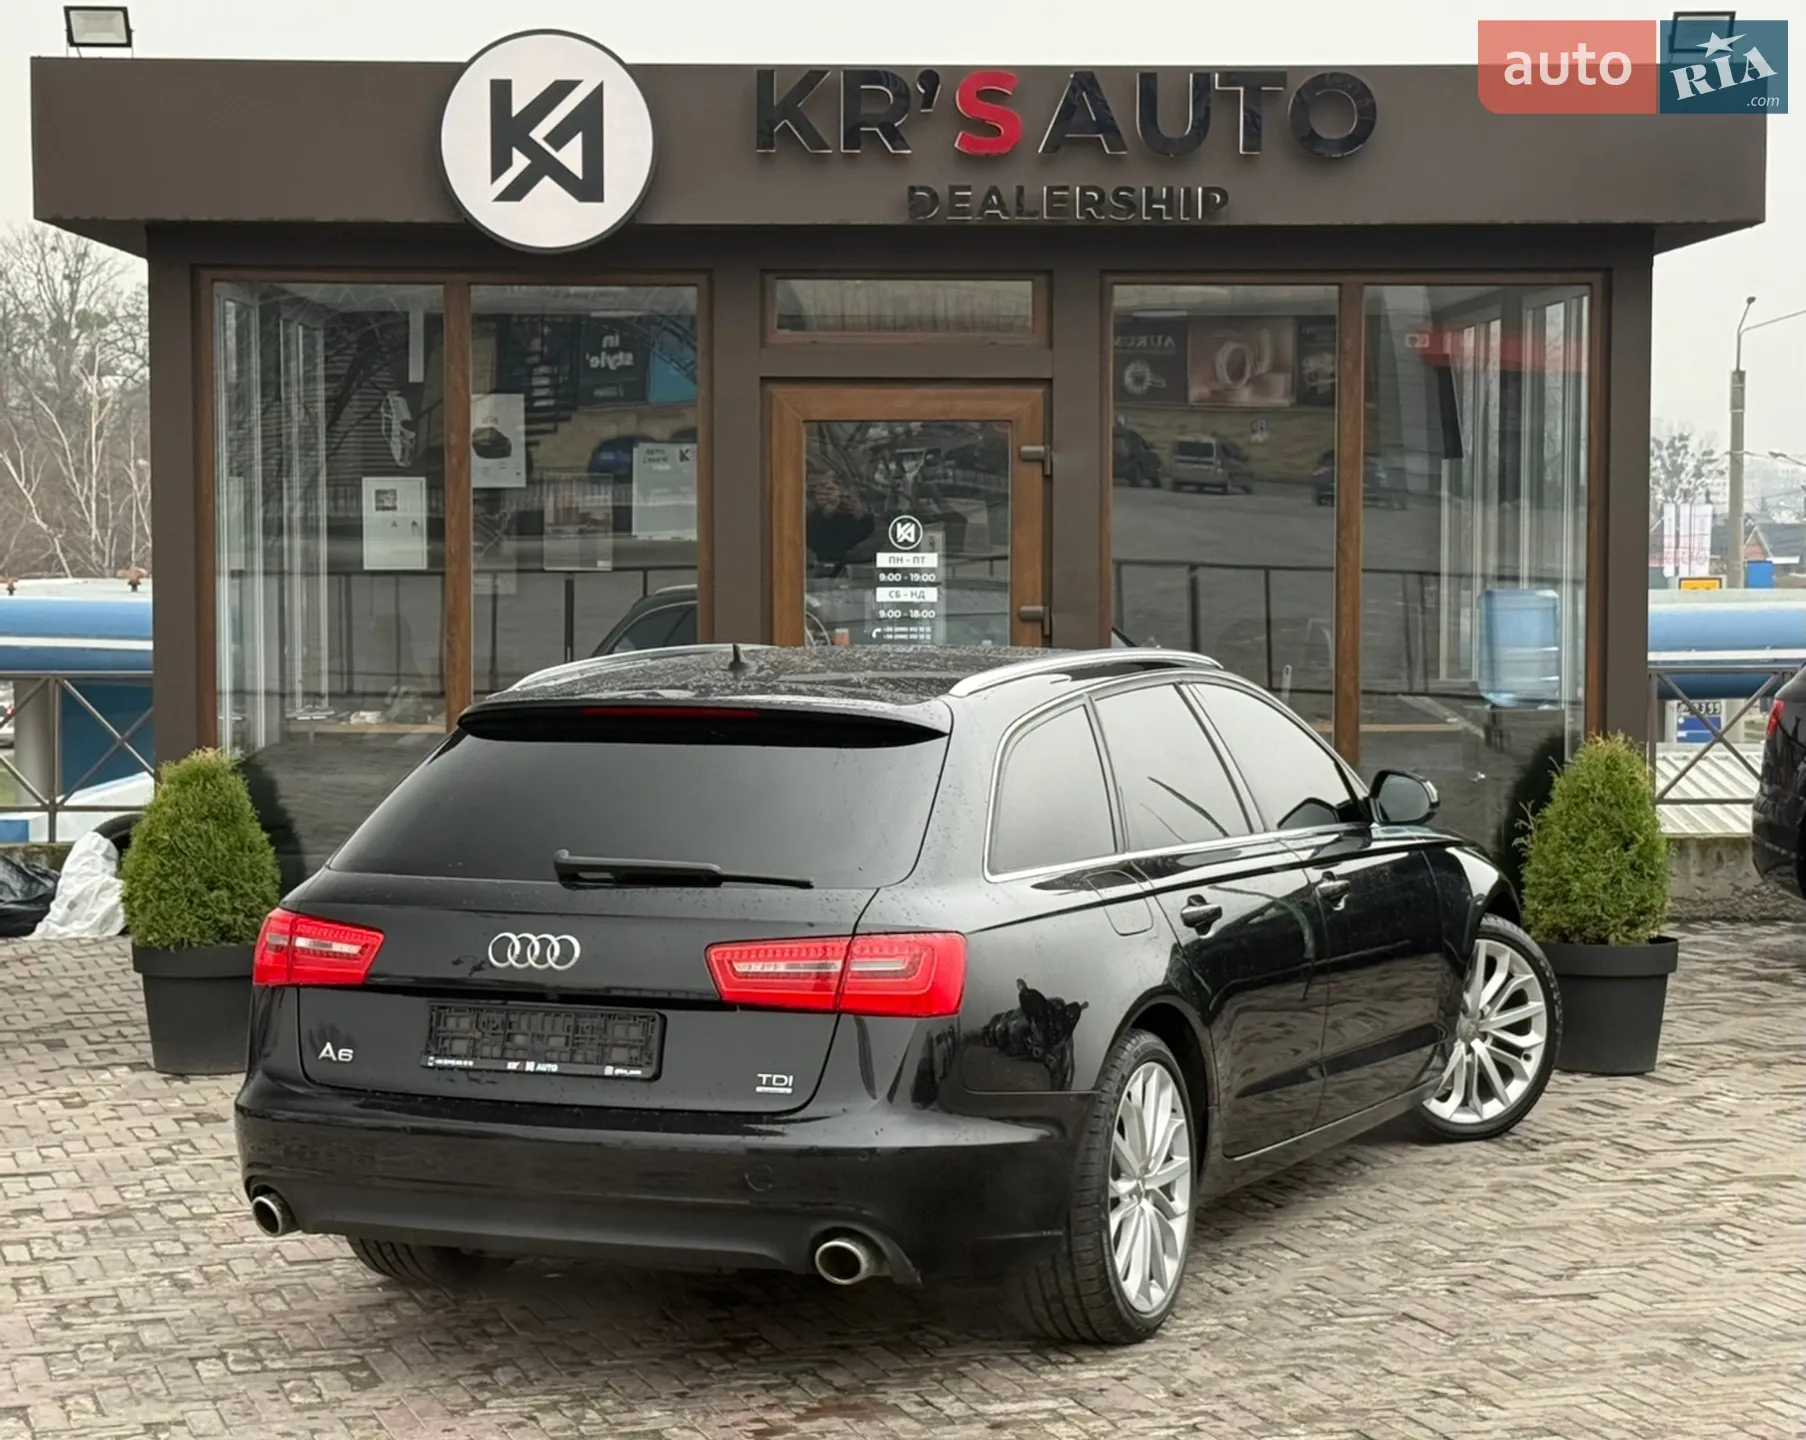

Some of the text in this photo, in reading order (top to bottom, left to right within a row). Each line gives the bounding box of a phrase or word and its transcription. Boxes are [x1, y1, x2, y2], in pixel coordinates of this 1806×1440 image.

[755, 69, 1378, 158] KR'S AUTO
[907, 184, 1230, 222] DEALERSHIP
[888, 556, 903, 564] ПН
[912, 556, 926, 564] ПТ
[879, 573, 902, 582] 9:00
[909, 573, 936, 582] 19:00
[888, 590, 901, 599] СБ
[910, 590, 926, 600] НД
[879, 609, 902, 619] 9:00
[318, 1041, 354, 1062] A6
[757, 1073, 794, 1087] TDI
